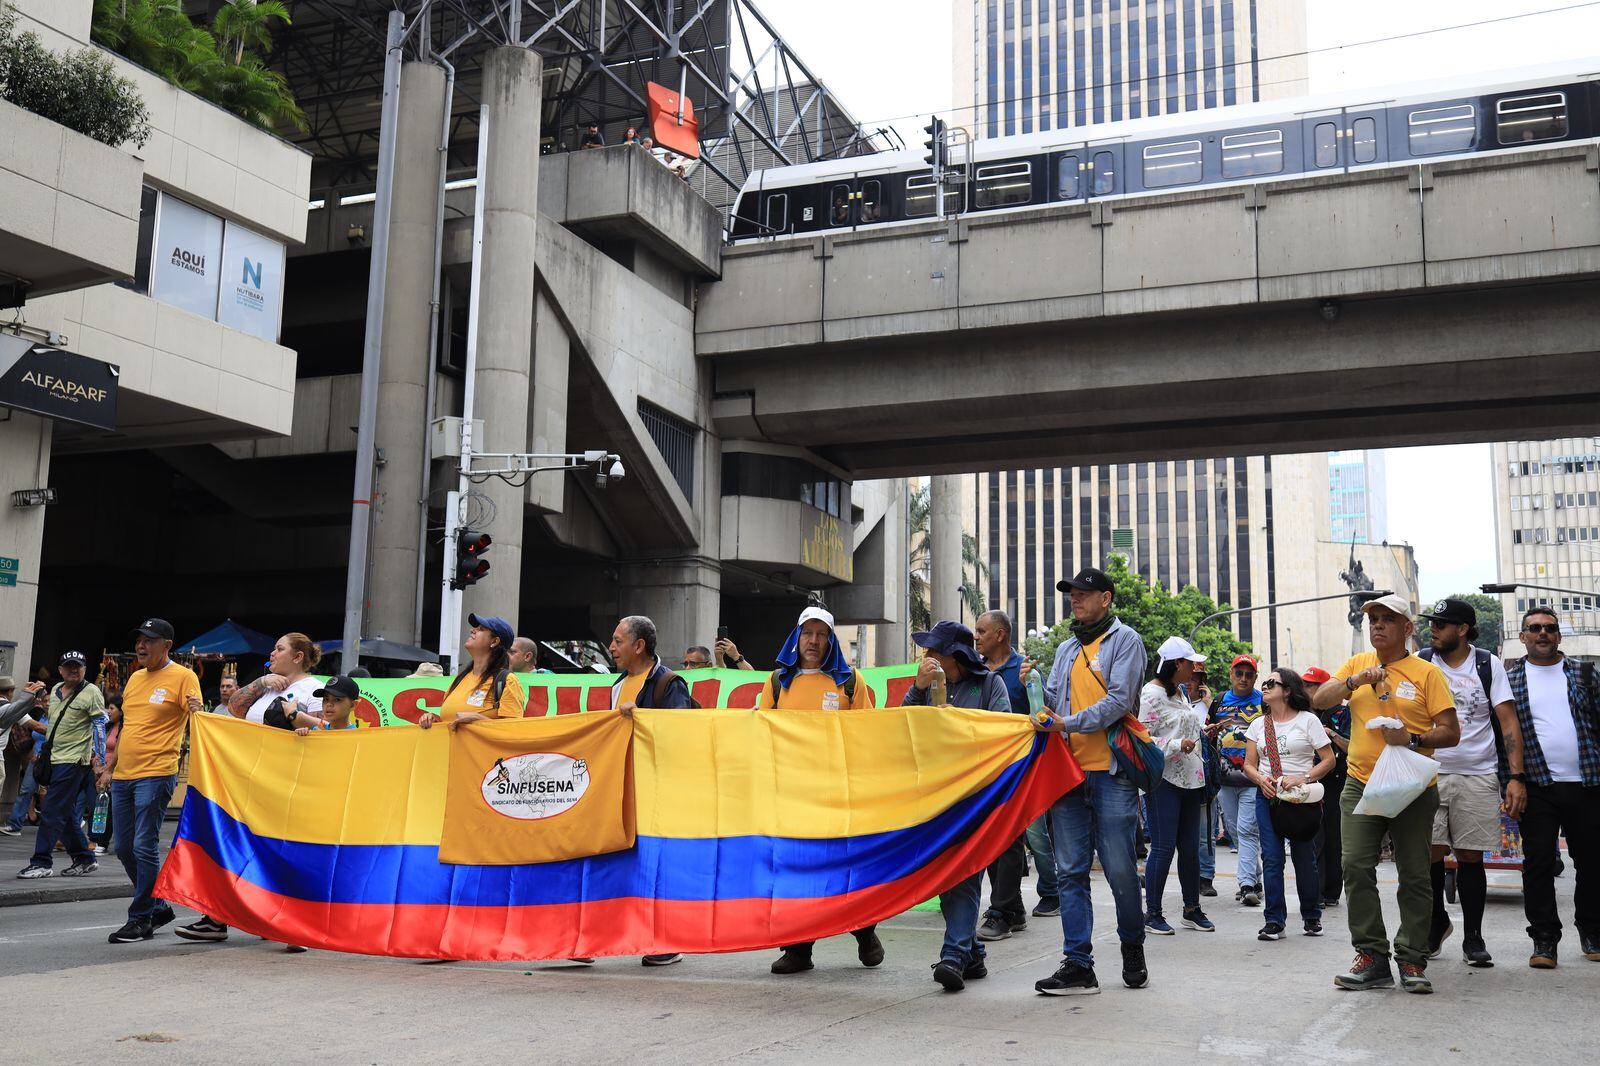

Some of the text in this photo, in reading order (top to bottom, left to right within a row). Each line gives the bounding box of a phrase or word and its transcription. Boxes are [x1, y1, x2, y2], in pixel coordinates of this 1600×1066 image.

[172, 247, 205, 268] AQUÍ
[171, 258, 205, 276] ESTAMOS
[242, 257, 262, 289] N
[236, 287, 264, 302] NUTIBARA
[21, 371, 107, 402] ALFAPARF
[49, 392, 79, 403] MILANO
[1558, 455, 1600, 463] CURAD
[63, 651, 84, 660] ICON
[359, 689, 384, 708] LANTES
[497, 780, 574, 795] SINFUSENA
